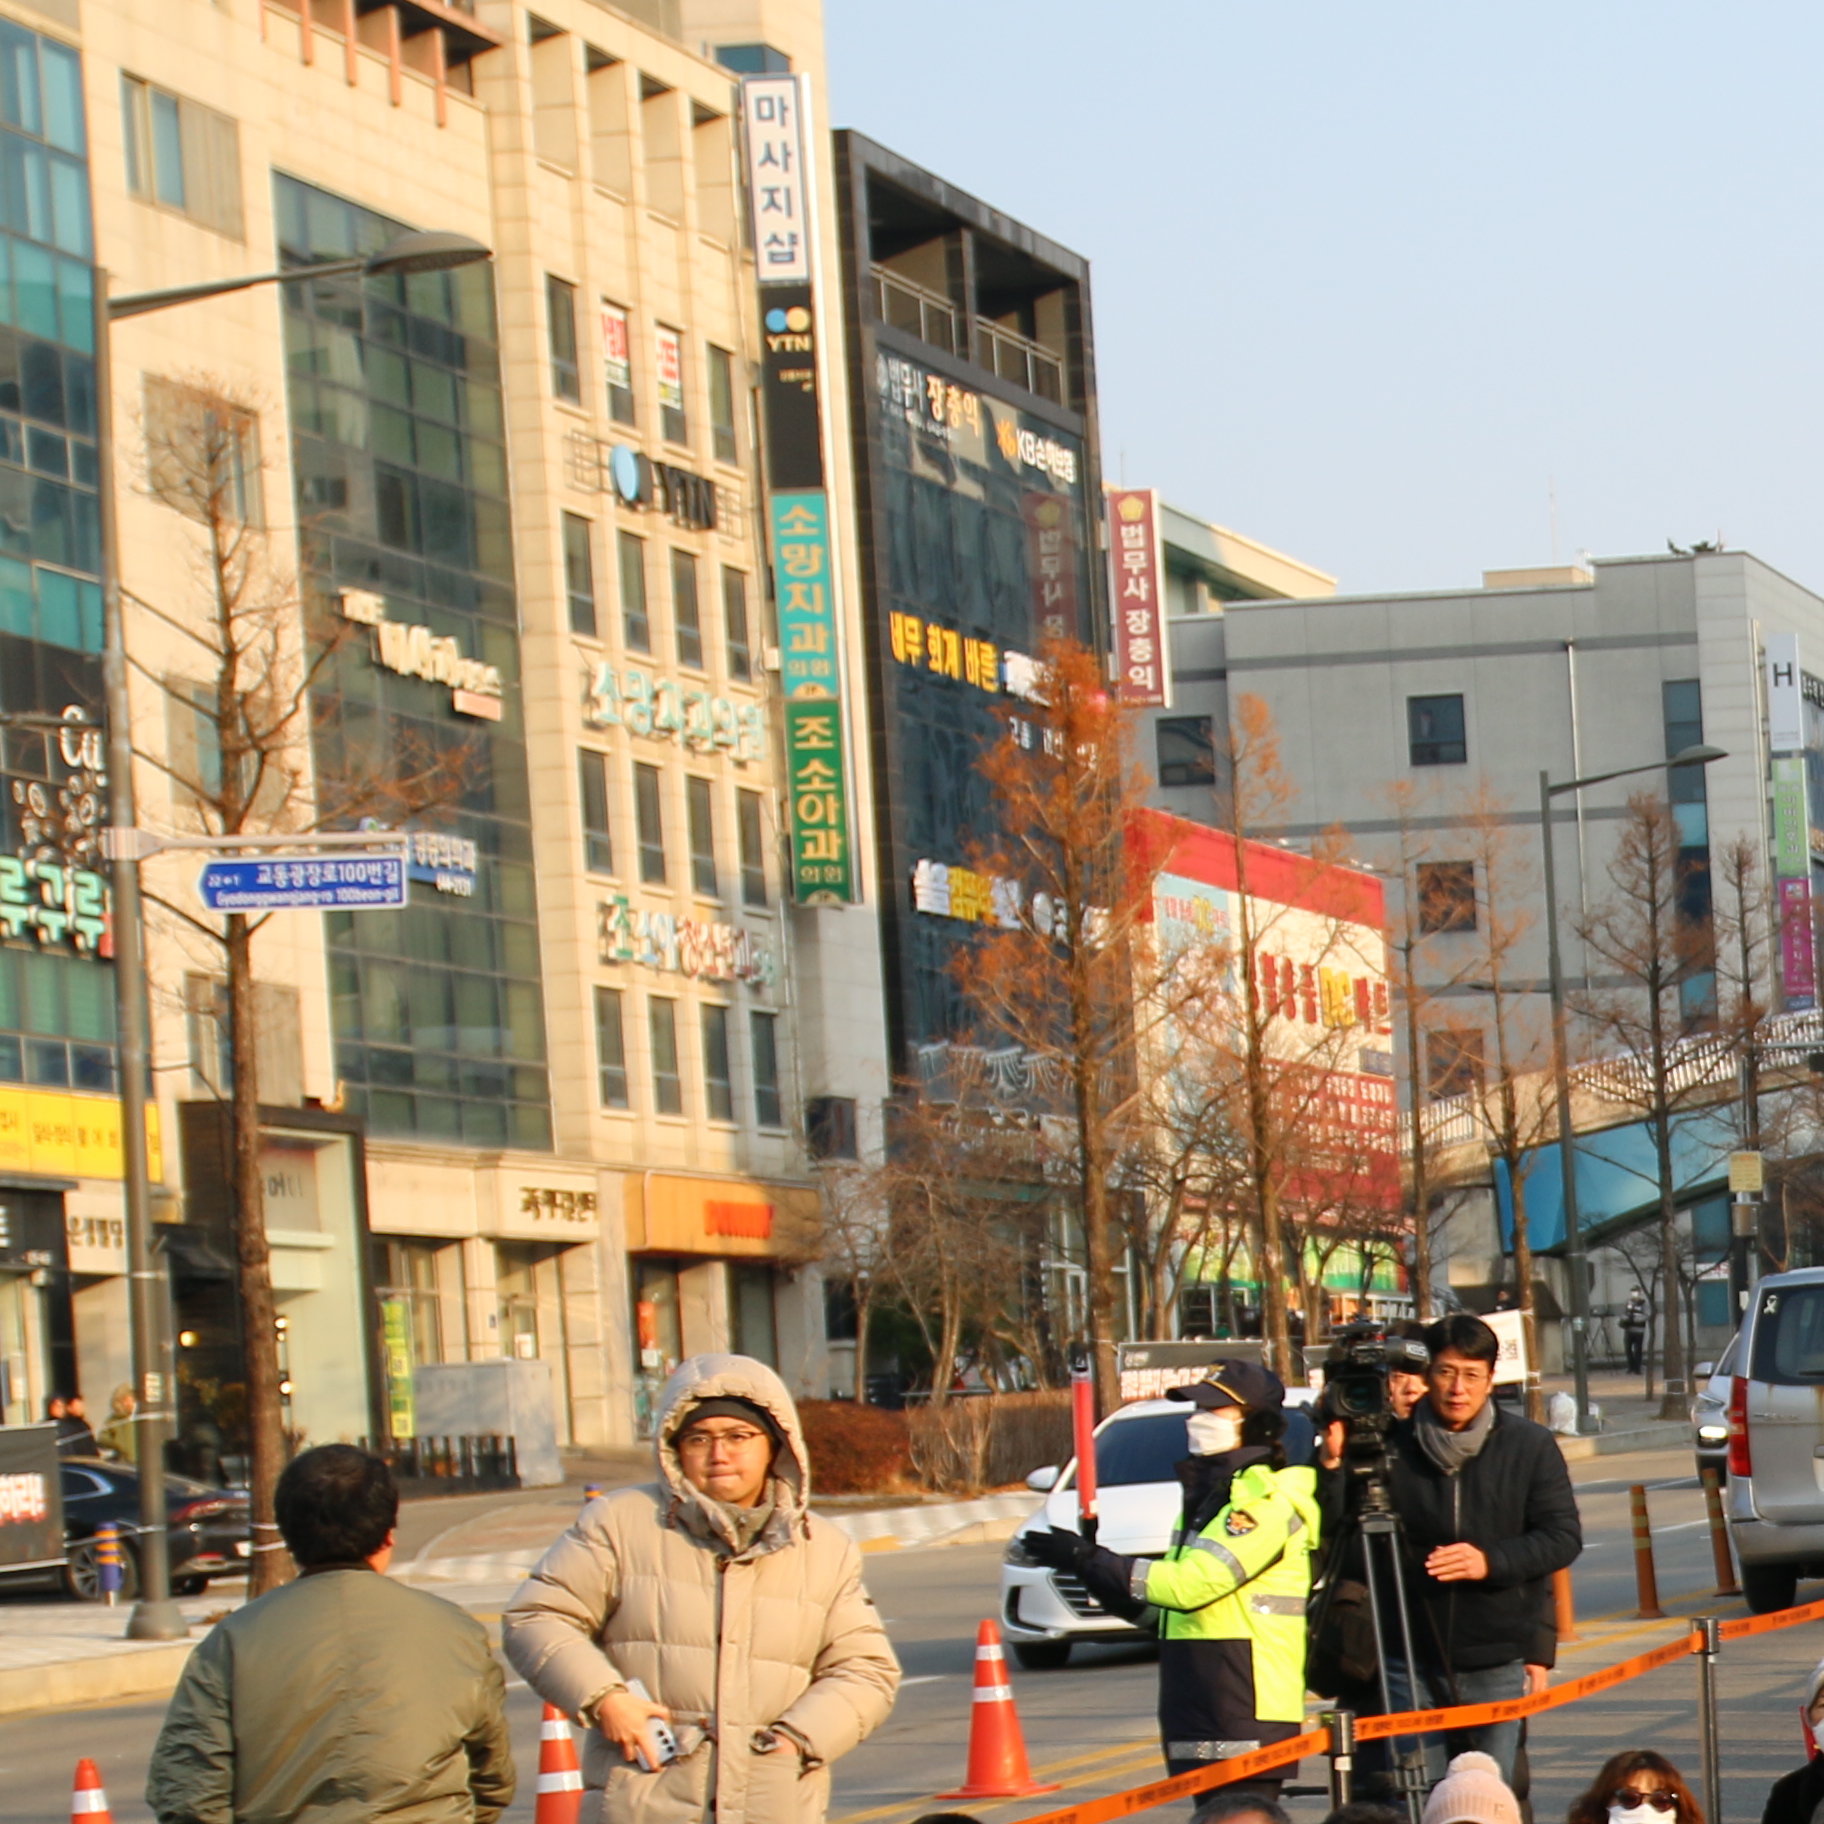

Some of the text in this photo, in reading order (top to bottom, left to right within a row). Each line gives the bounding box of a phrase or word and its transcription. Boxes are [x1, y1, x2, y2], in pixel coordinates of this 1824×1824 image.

[755, 91, 801, 265] 마사지샵
[766, 334, 811, 353] YTN
[776, 501, 830, 653] 소망치과
[1121, 522, 1156, 692] 법무사 장충익
[794, 715, 842, 861] 조 소아과
